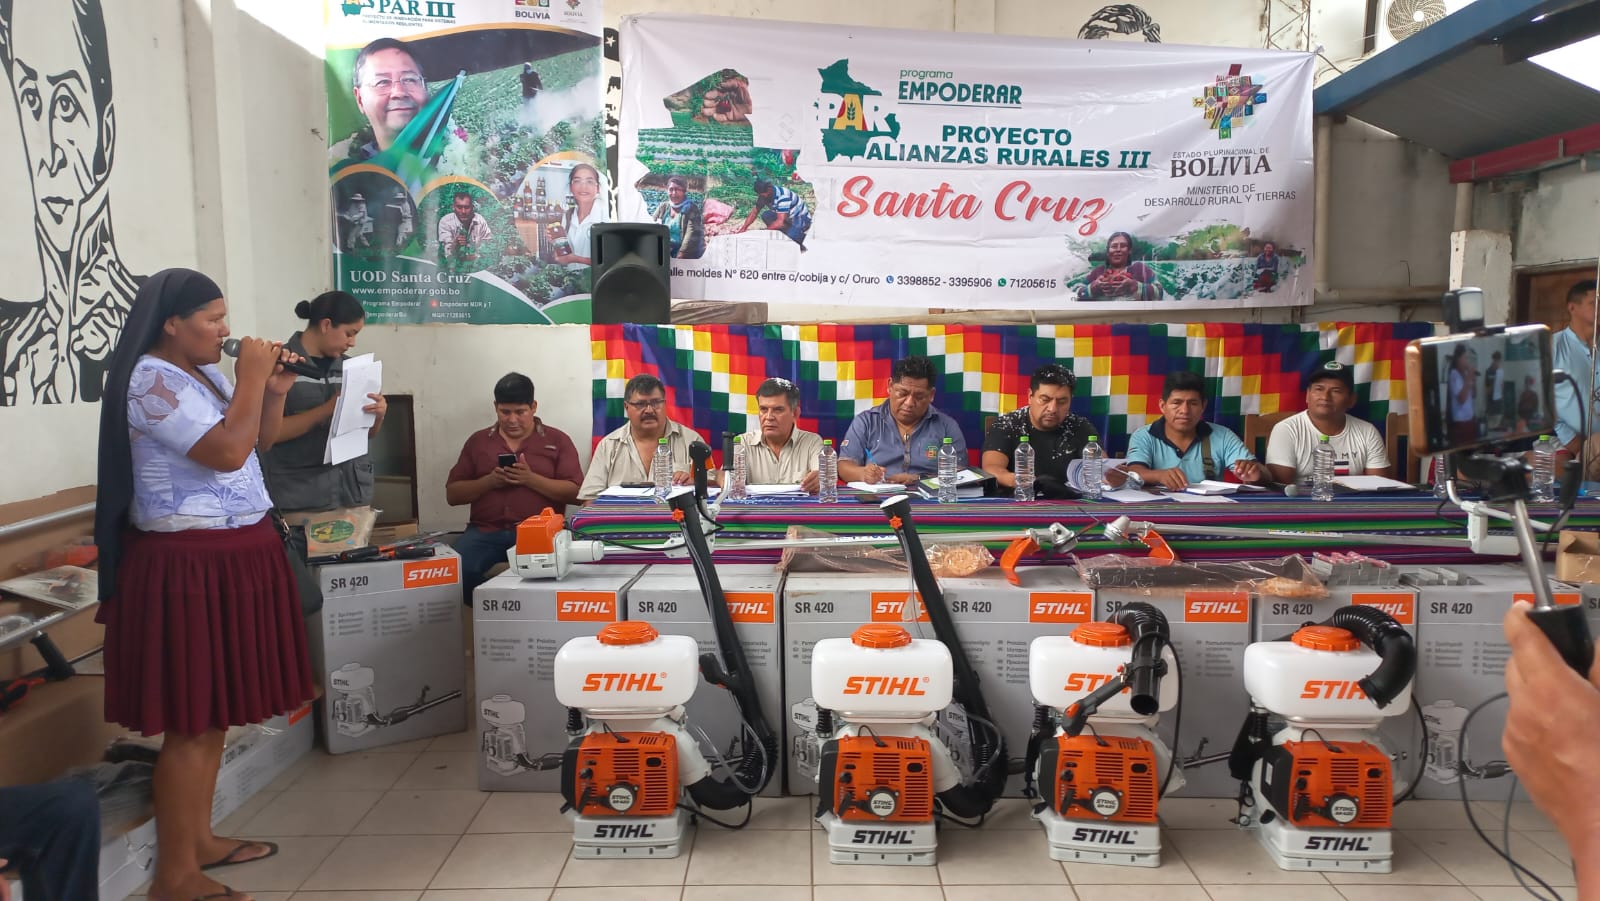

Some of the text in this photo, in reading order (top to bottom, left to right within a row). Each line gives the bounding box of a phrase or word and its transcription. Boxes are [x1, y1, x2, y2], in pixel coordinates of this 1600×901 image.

[379, 0, 456, 18] PAR III
[515, 11, 550, 20] BOLIVIA
[900, 70, 953, 79] programa
[898, 81, 1023, 104] EMPODERAR
[817, 93, 892, 132] PAR
[942, 125, 1072, 146] PROYECTO
[866, 142, 1151, 169] ALIANZAS RURALES III
[1172, 151, 1201, 159] ESTADO
[1203, 148, 1256, 157] PLURINACIONAL
[1170, 155, 1272, 178] BOLIVIA
[1186, 184, 1256, 195] MINISTERIO DE
[837, 175, 1113, 236] Santa Cruz
[1144, 191, 1296, 207] DESARROLLO RURAL Y TIERRAS
[349, 271, 472, 284] UOD Santa Cruz
[670, 267, 881, 285] alle moldes N° 620 entre c/cobija y c/ Oruro
[897, 275, 941, 286] 3398852
[948, 277, 992, 288] 3395906
[1010, 278, 1057, 288] 71205615
[352, 287, 460, 297] www.empoderar.gob.bo
[408, 566, 453, 581] STIHL
[331, 575, 369, 590] SR 420
[482, 600, 521, 611] SR 420
[560, 601, 610, 613] STIHL
[638, 602, 677, 613] SR 420
[726, 602, 768, 614] TIHL
[794, 602, 834, 613] SR 420
[952, 601, 992, 613] SR 420
[1033, 602, 1085, 615] STIHL
[1189, 602, 1242, 613] STIHL
[1272, 603, 1313, 615] SR 420
[1430, 603, 1473, 614] SR 420
[582, 673, 664, 692] STIHL
[843, 676, 926, 696] STIHL
[1300, 680, 1366, 699] STIH
[594, 825, 654, 838] STIHL
[852, 830, 913, 844] STIHL
[1072, 828, 1135, 845] STIHL
[1305, 836, 1370, 851] STIHL
